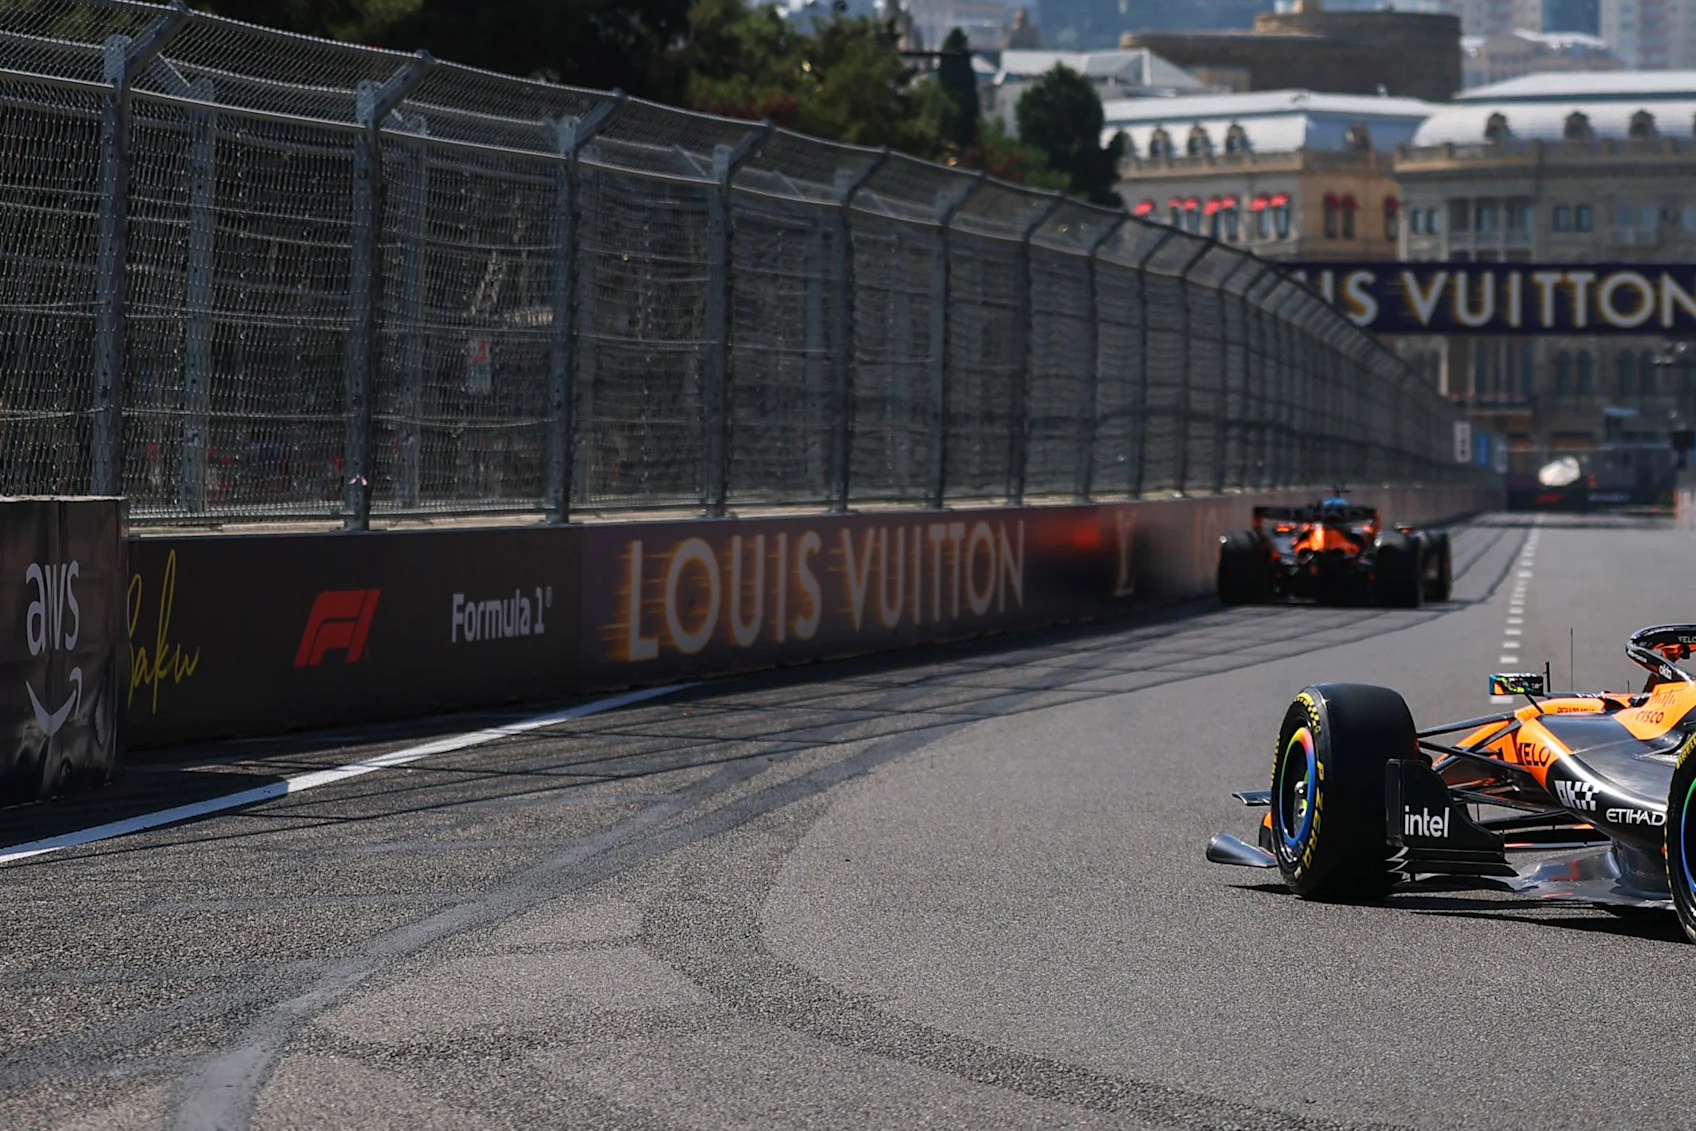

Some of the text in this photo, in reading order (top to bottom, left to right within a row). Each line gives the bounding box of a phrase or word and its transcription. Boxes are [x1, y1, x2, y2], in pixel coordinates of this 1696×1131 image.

[25, 560, 80, 656] aws
[628, 530, 823, 661] LOUIS
[841, 518, 1025, 633] VUITTON
[452, 588, 531, 643] Formula
[1635, 710, 1665, 725] CISCO
[1404, 805, 1450, 838] intel
[1606, 807, 1667, 827] ETIHAD
